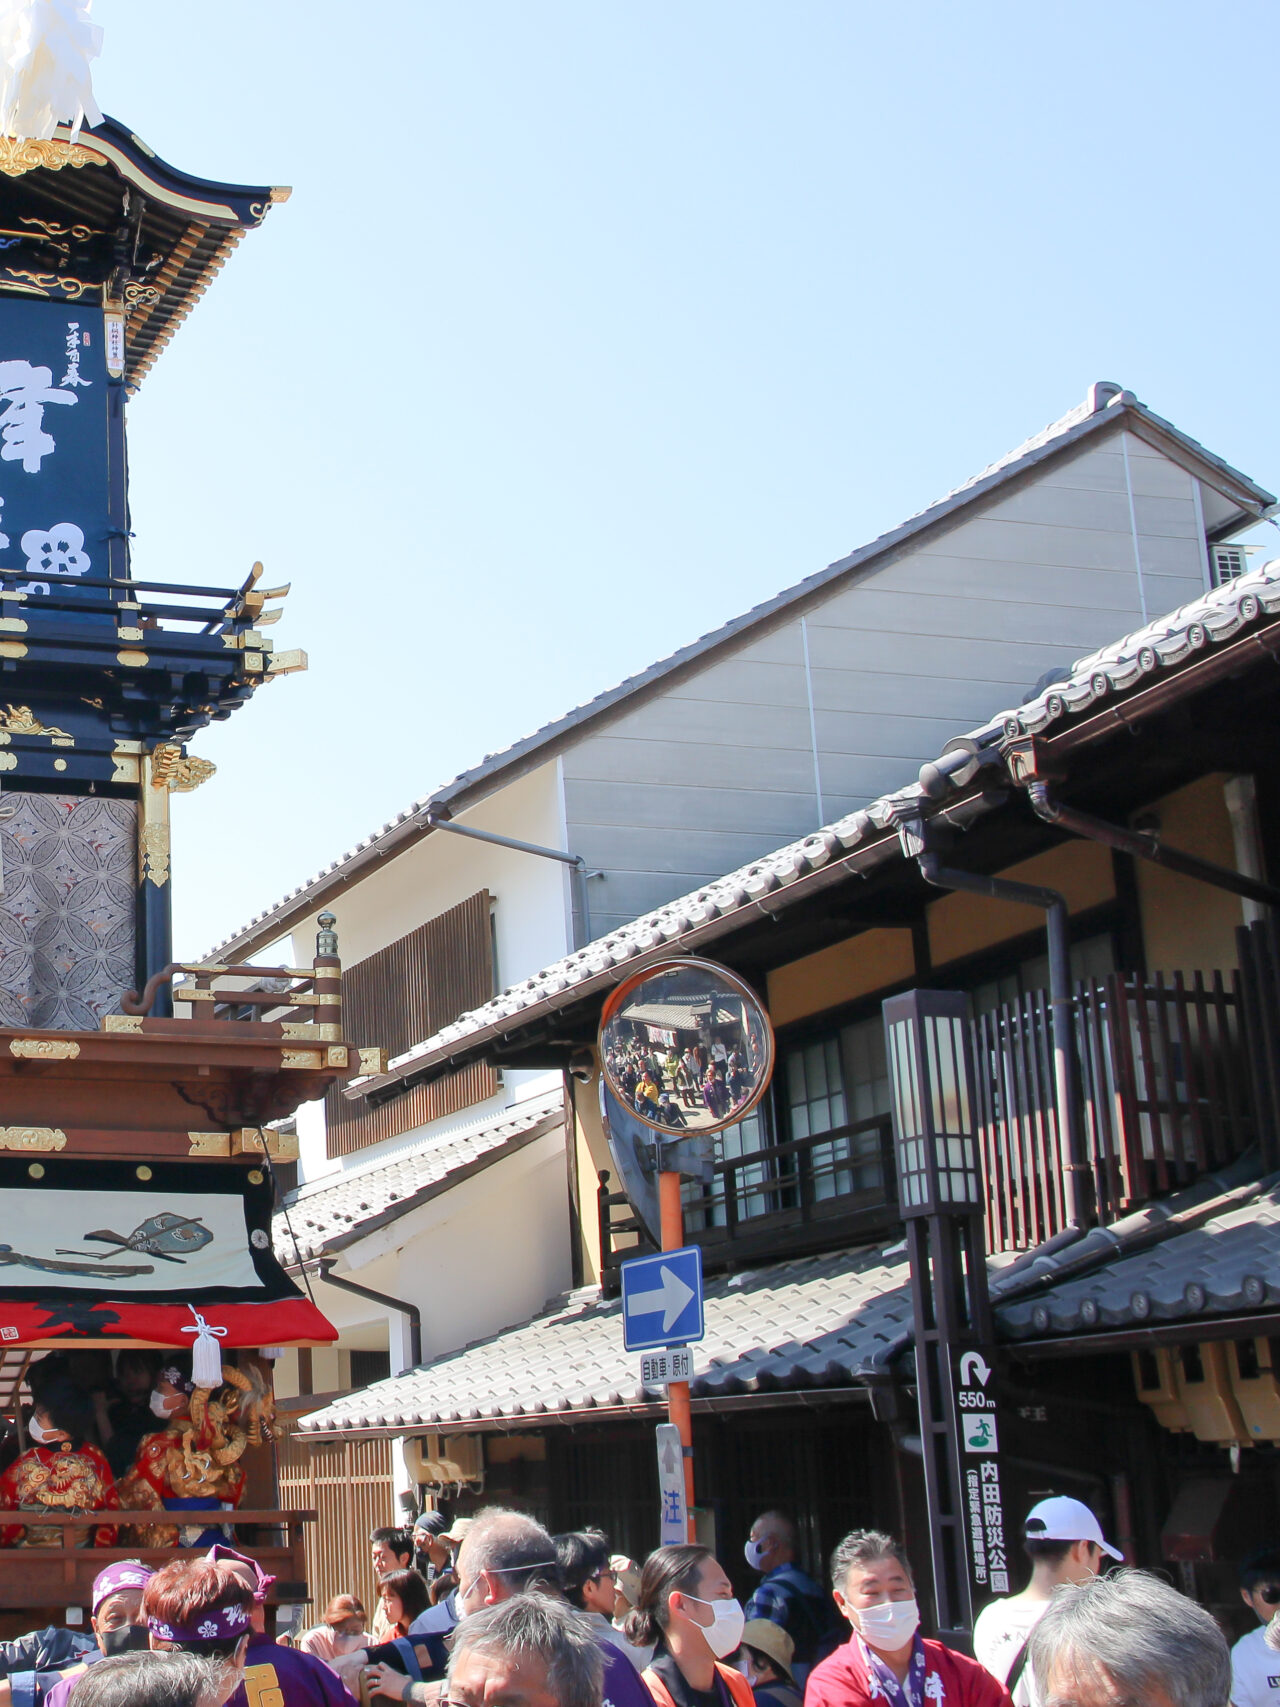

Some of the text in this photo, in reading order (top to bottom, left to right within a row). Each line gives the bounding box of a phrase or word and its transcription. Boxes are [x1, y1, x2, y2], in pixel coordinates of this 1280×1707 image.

[980, 1461, 1009, 1592] 内田防災公園
